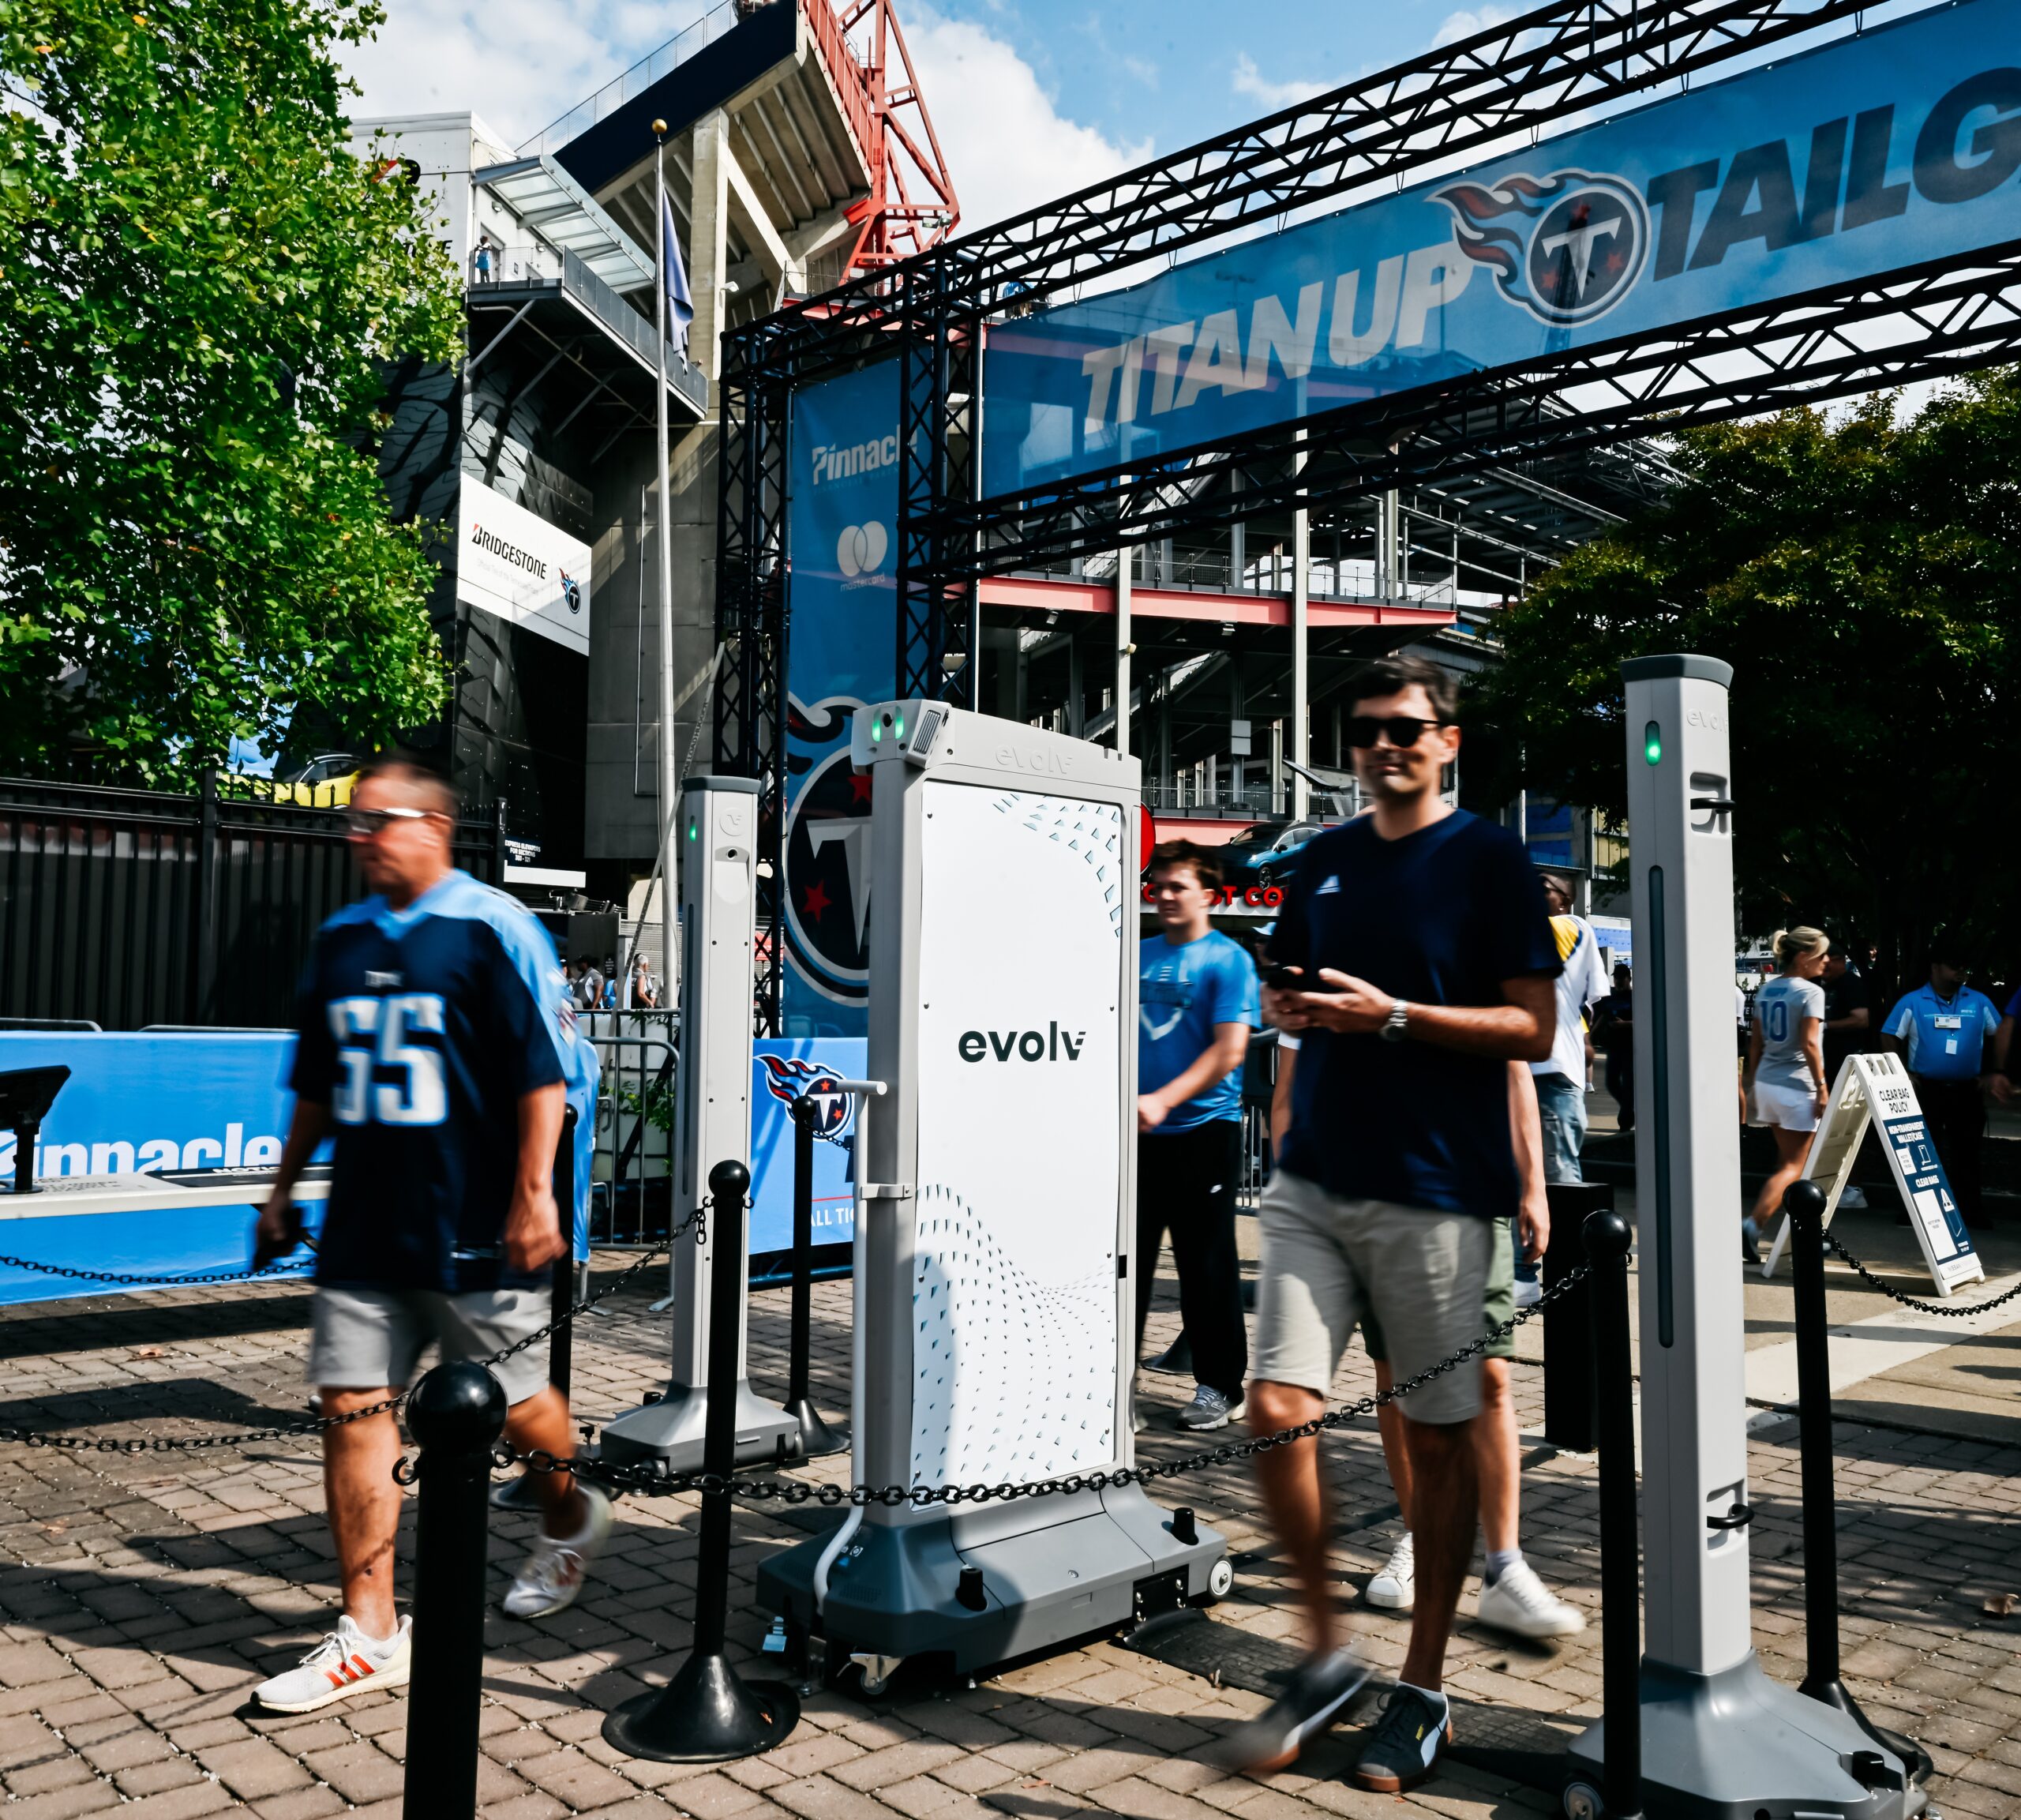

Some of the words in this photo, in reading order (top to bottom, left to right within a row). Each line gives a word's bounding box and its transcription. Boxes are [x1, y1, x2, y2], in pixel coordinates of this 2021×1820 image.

[1648, 67, 2021, 282] TAILG
[1081, 281, 1324, 435] TITAN
[1329, 240, 1475, 366] UP
[472, 523, 547, 580] BRIDGESTONE
[840, 572, 885, 592] mastercard
[1245, 886, 1288, 907] CO
[1760, 999, 1787, 1042] 10
[958, 1021, 1086, 1063] evolv
[1879, 1089, 1899, 1101] CLEAR
[1897, 1087, 1910, 1099] BAG
[1888, 1101, 1909, 1114] POLICY
